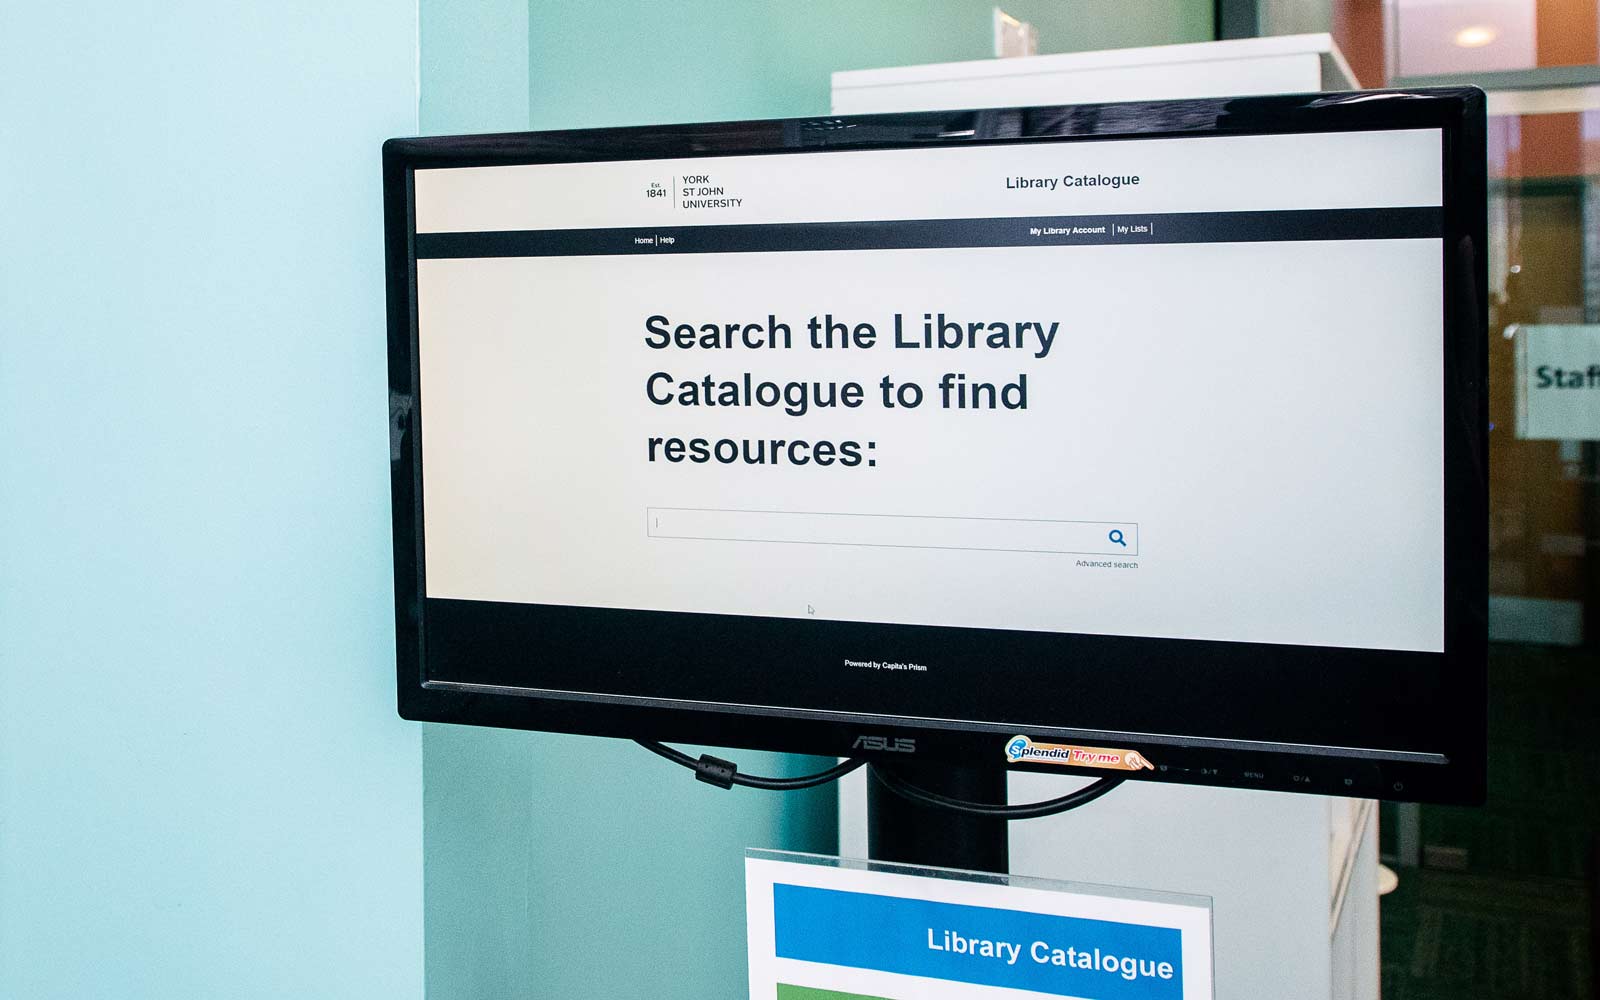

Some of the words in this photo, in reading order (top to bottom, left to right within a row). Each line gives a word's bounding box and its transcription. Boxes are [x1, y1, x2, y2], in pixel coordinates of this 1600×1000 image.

[682, 175, 710, 184] YORK
[1006, 176, 1058, 190] Library
[1063, 174, 1140, 188] Catalogue
[646, 189, 666, 198] 1841
[682, 188, 696, 196] ST
[697, 187, 724, 196] JOHN
[682, 199, 742, 208] UNIVERSITY
[1030, 227, 1041, 235] My
[1043, 226, 1071, 235] Library
[1072, 226, 1106, 234] Account
[1117, 225, 1129, 233] My
[1131, 224, 1148, 233] Lists
[660, 236, 675, 244] Help
[644, 314, 793, 350] Search
[807, 314, 877, 350] the
[894, 313, 1060, 359] Library
[646, 371, 865, 417] Catalogue
[879, 374, 924, 409] to
[938, 373, 1028, 410] find
[647, 435, 877, 467] resources:
[1076, 559, 1112, 568] Advanced
[1113, 561, 1138, 569] search
[844, 659, 872, 668] Powered
[873, 661, 881, 670] by
[882, 662, 908, 671] Capita's
[908, 663, 928, 671] Prism
[852, 735, 916, 753] ASUS
[1009, 739, 1070, 759] Splendid
[1073, 750, 1096, 763] Try
[1098, 754, 1120, 763] me
[927, 928, 1022, 964] Library
[1030, 940, 1175, 980] Catalogue
